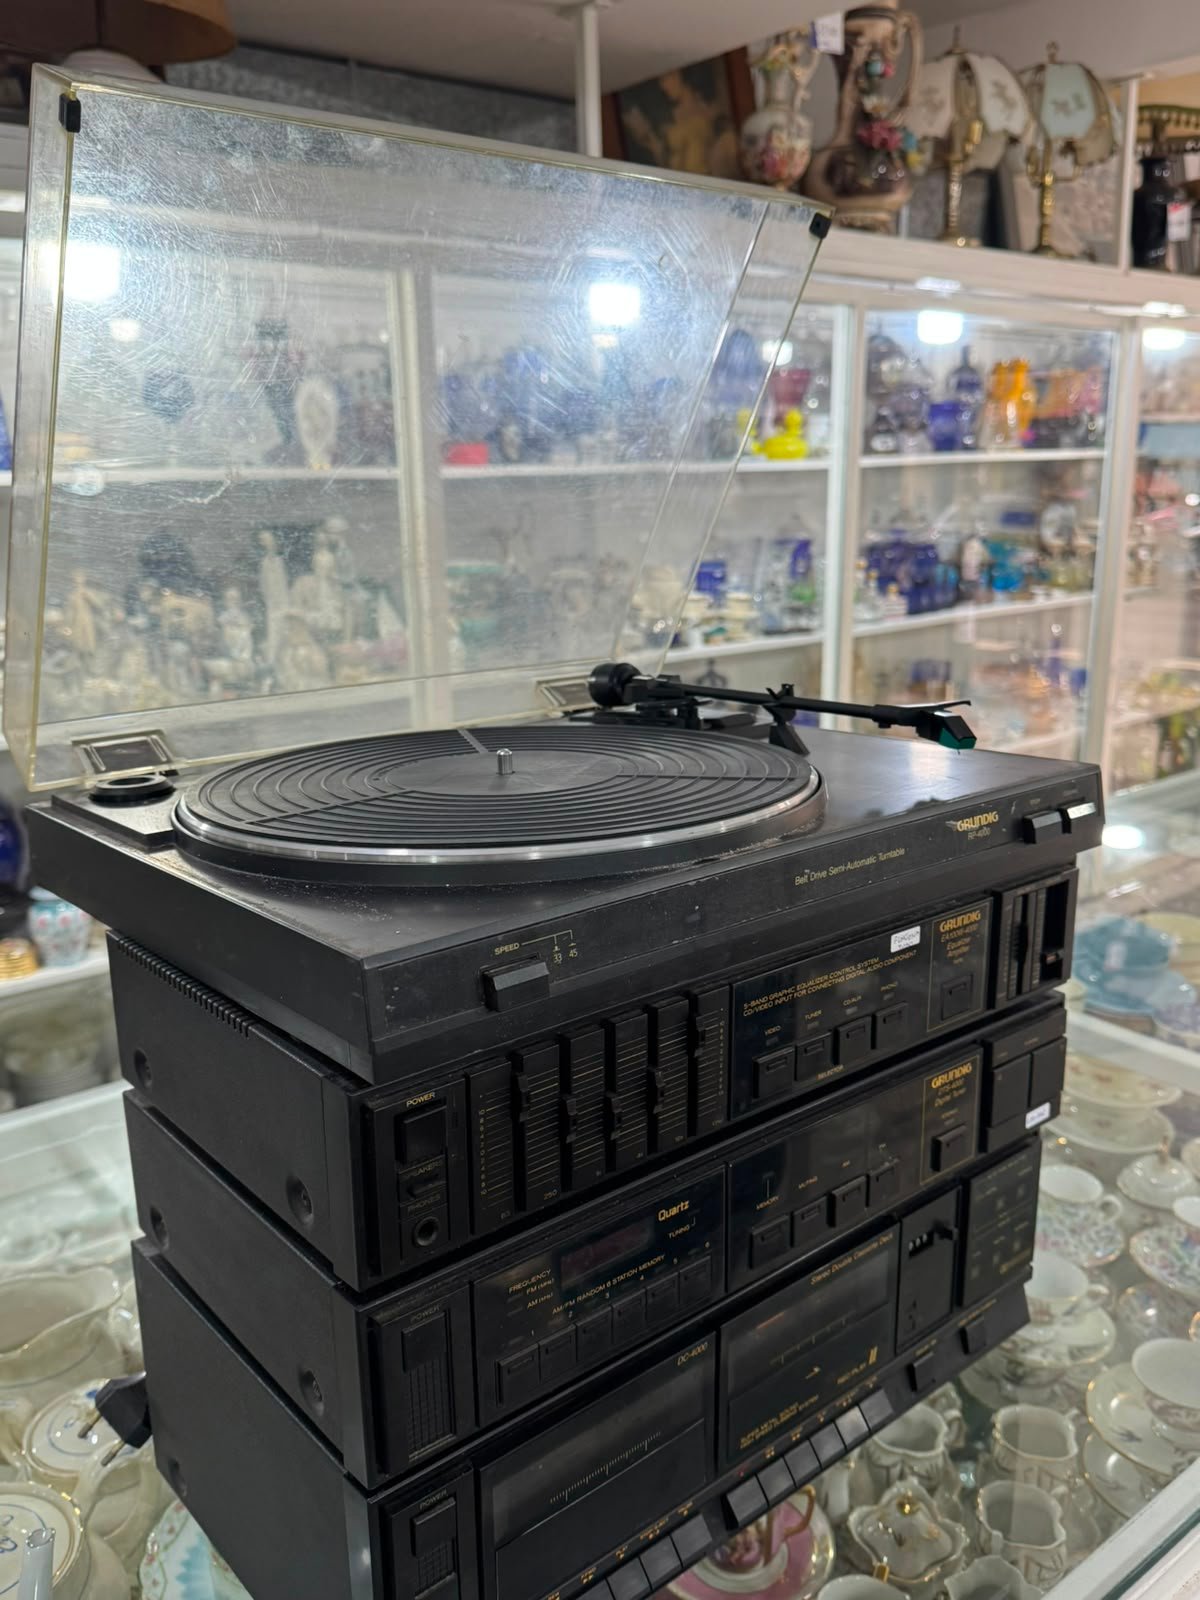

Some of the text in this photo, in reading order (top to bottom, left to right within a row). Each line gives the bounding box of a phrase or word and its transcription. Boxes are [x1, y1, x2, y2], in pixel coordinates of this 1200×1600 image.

[957, 811, 999, 832] GRUNDIG
[794, 848, 905, 886] Belt Drive Semi-Automatic Turntable
[940, 910, 981, 932] GRUNDIG
[494, 942, 520, 955] SPEED
[769, 986, 796, 1001] GRAPHIC
[796, 974, 829, 991] EQUALIZER
[829, 965, 857, 979] CONTROL
[857, 957, 880, 970] SYSTEM
[774, 994, 793, 1006] INPUT
[793, 989, 807, 998] FOR
[807, 975, 845, 994] CONNECTING
[845, 969, 866, 981] DIGITAL
[866, 962, 884, 972] AUDIO
[884, 949, 917, 967] COMPONENT
[804, 1009, 822, 1021] TUNER
[764, 1025, 782, 1036] VIDEO
[931, 1061, 973, 1089] GRUNDIG
[406, 1092, 436, 1108] POWER
[657, 1199, 690, 1222] Quartz
[667, 1223, 691, 1239] TUNING
[508, 1268, 552, 1294] FREQUENCY
[576, 1283, 606, 1305] RANDOM
[612, 1268, 638, 1287] STATION
[638, 1253, 666, 1271] MEMORY
[526, 1285, 539, 1296] FM
[410, 1304, 441, 1324] POWER
[526, 1299, 539, 1310] AM
